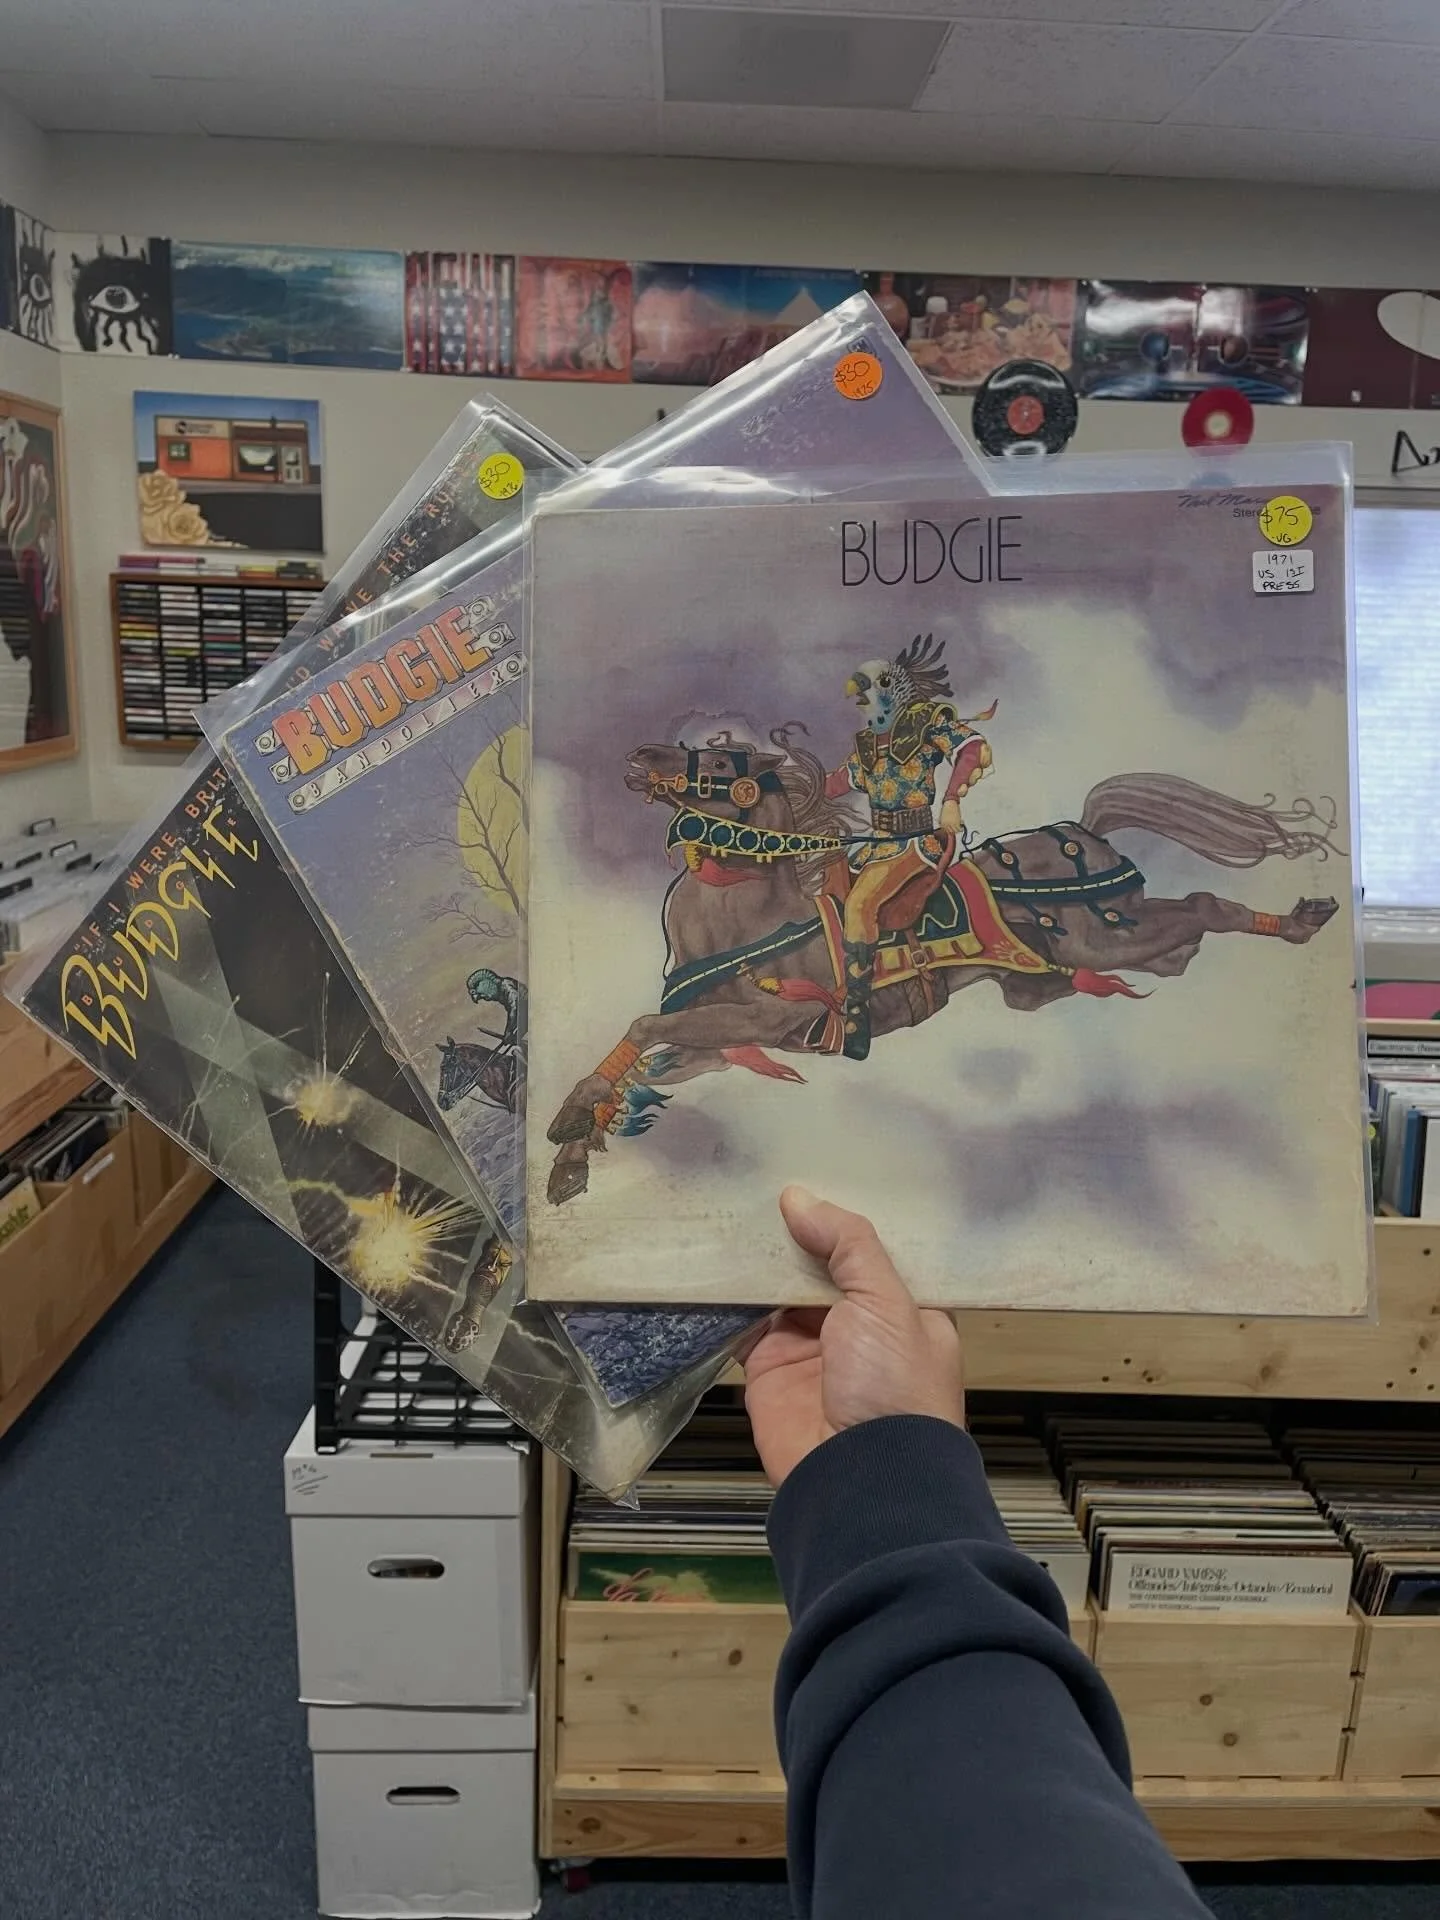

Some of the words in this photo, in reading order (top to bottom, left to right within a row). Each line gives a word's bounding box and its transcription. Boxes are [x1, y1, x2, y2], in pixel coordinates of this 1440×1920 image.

[835, 361, 870, 388] $30
[480, 461, 511, 493] $30
[1261, 504, 1304, 532] $75
[842, 516, 1023, 587] BUDGIE
[1267, 554, 1293, 565] 1971
[1257, 569, 1275, 579] US
[1262, 580, 1300, 591] PRESS
[272, 604, 494, 776] BUDGIE
[125, 831, 177, 890] WERE
[376, 532, 417, 575] THE
[309, 668, 505, 799] BANDOLIER
[60, 804, 259, 1061] BUDGIE
